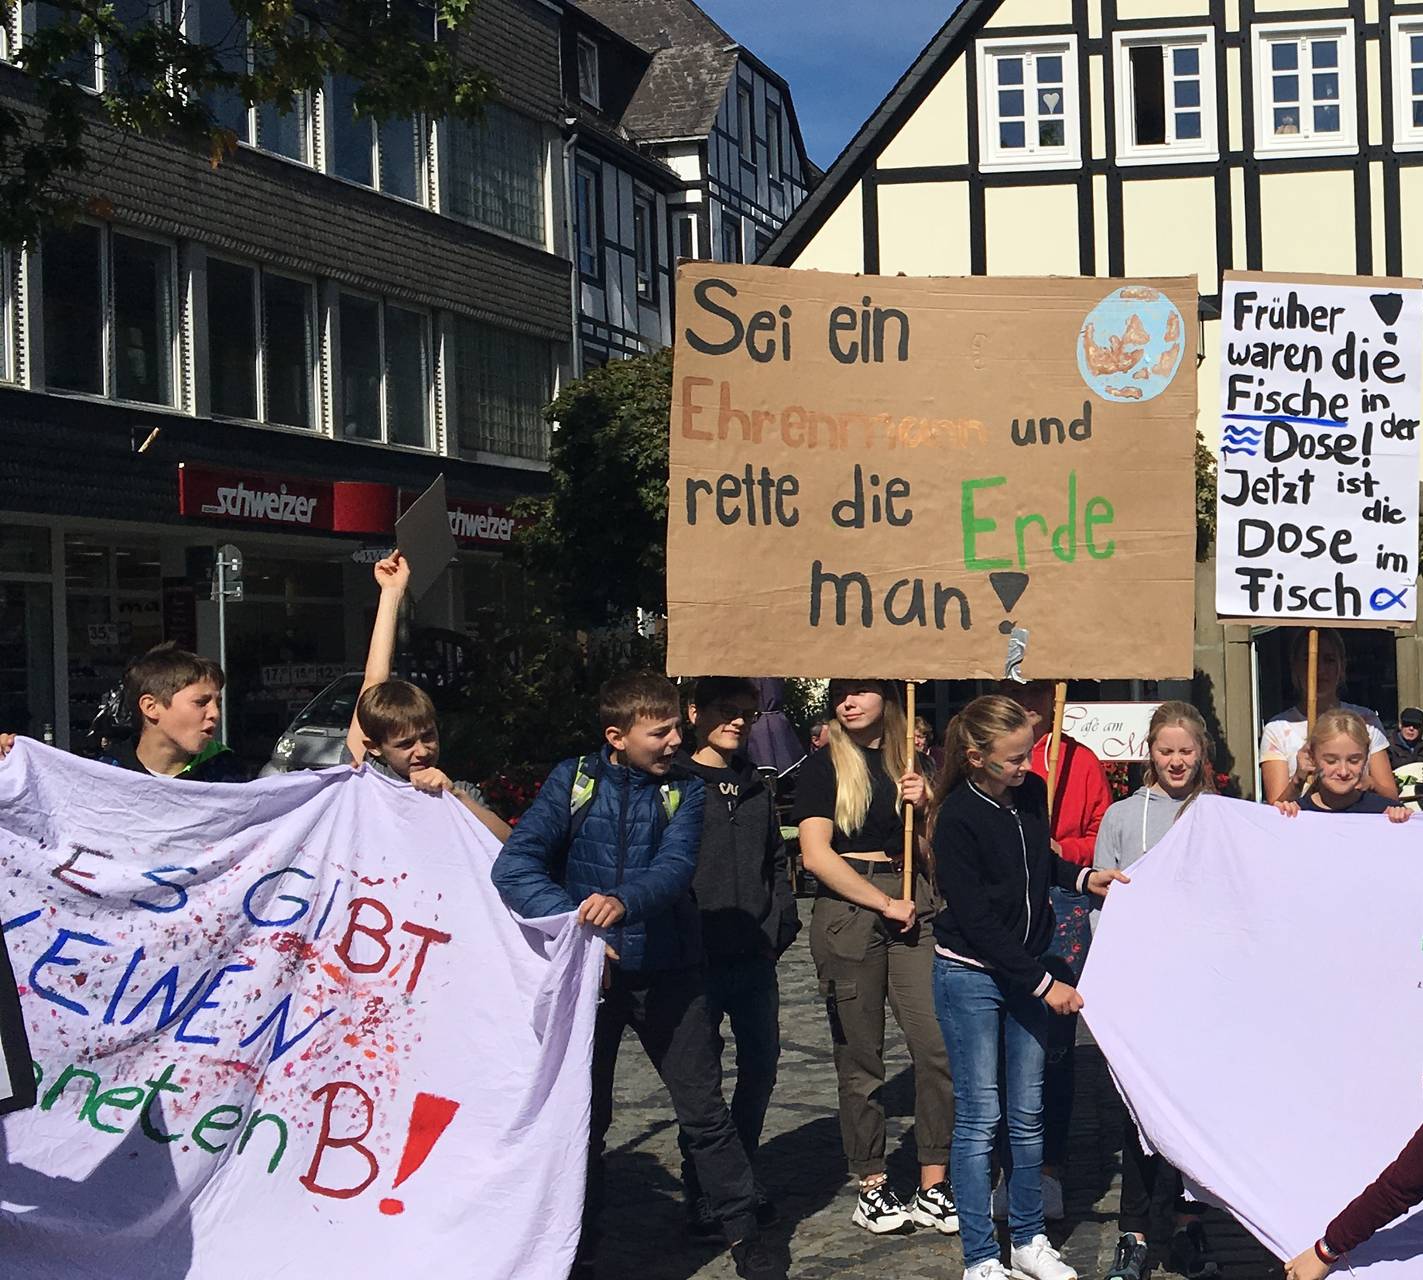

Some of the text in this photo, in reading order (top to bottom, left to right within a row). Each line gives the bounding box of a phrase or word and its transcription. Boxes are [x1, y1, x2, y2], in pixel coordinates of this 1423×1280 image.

[685, 278, 909, 363] Sei ein
[1234, 291, 1346, 335] Früher
[1228, 331, 1406, 383] waren die
[681, 376, 1092, 449] Ehrenmann und
[1227, 374, 1420, 441] Fische in der
[1264, 420, 1372, 468] Dose!
[686, 464, 1115, 572] rette die Erde
[1221, 467, 1407, 524] Jetzt ist die
[1376, 544, 1408, 573] im
[1235, 567, 1361, 617] Fisch
[1102, 722, 1124, 732] am
[51, 843, 452, 993] ES GIBT
[31, 1060, 288, 1173] neten
